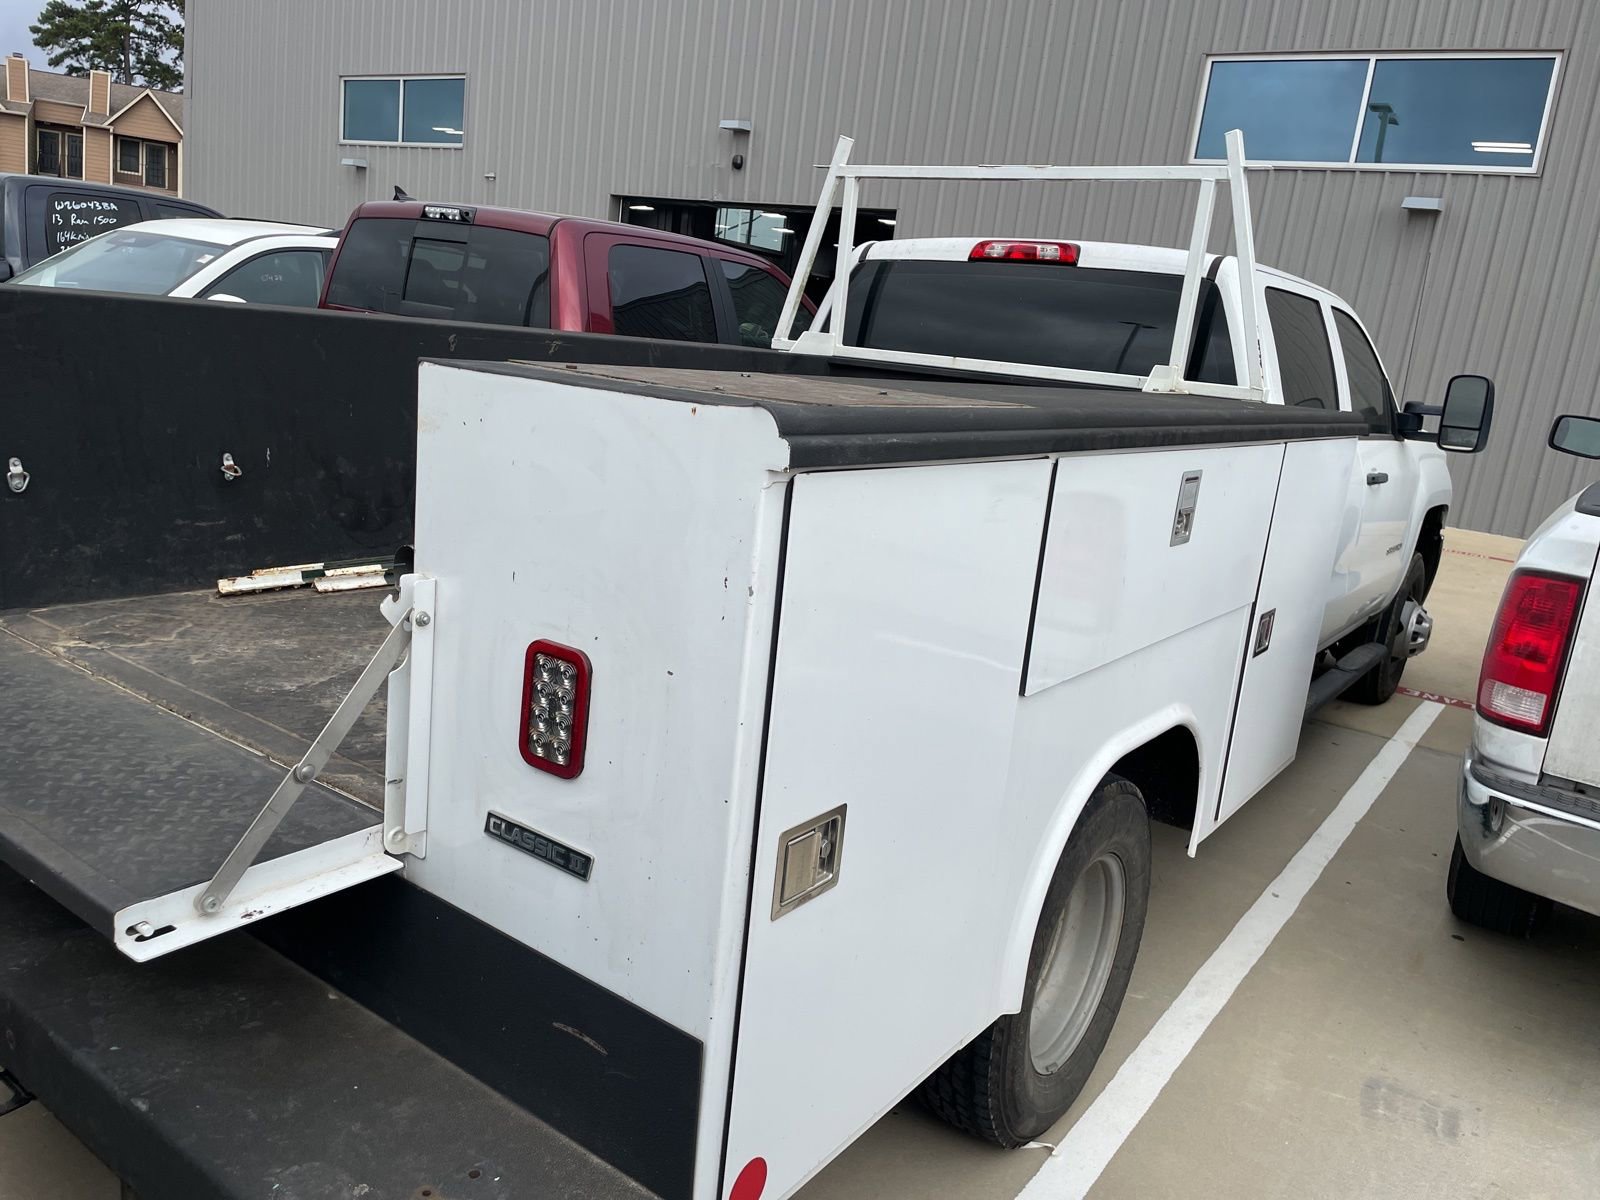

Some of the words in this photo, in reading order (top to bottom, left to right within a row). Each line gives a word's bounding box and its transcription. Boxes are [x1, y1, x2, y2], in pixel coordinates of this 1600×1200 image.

[52, 213, 63, 226] 13
[70, 213, 89, 226] Ram
[93, 215, 117, 225] 1500
[489, 817, 566, 866] CLASSIC
